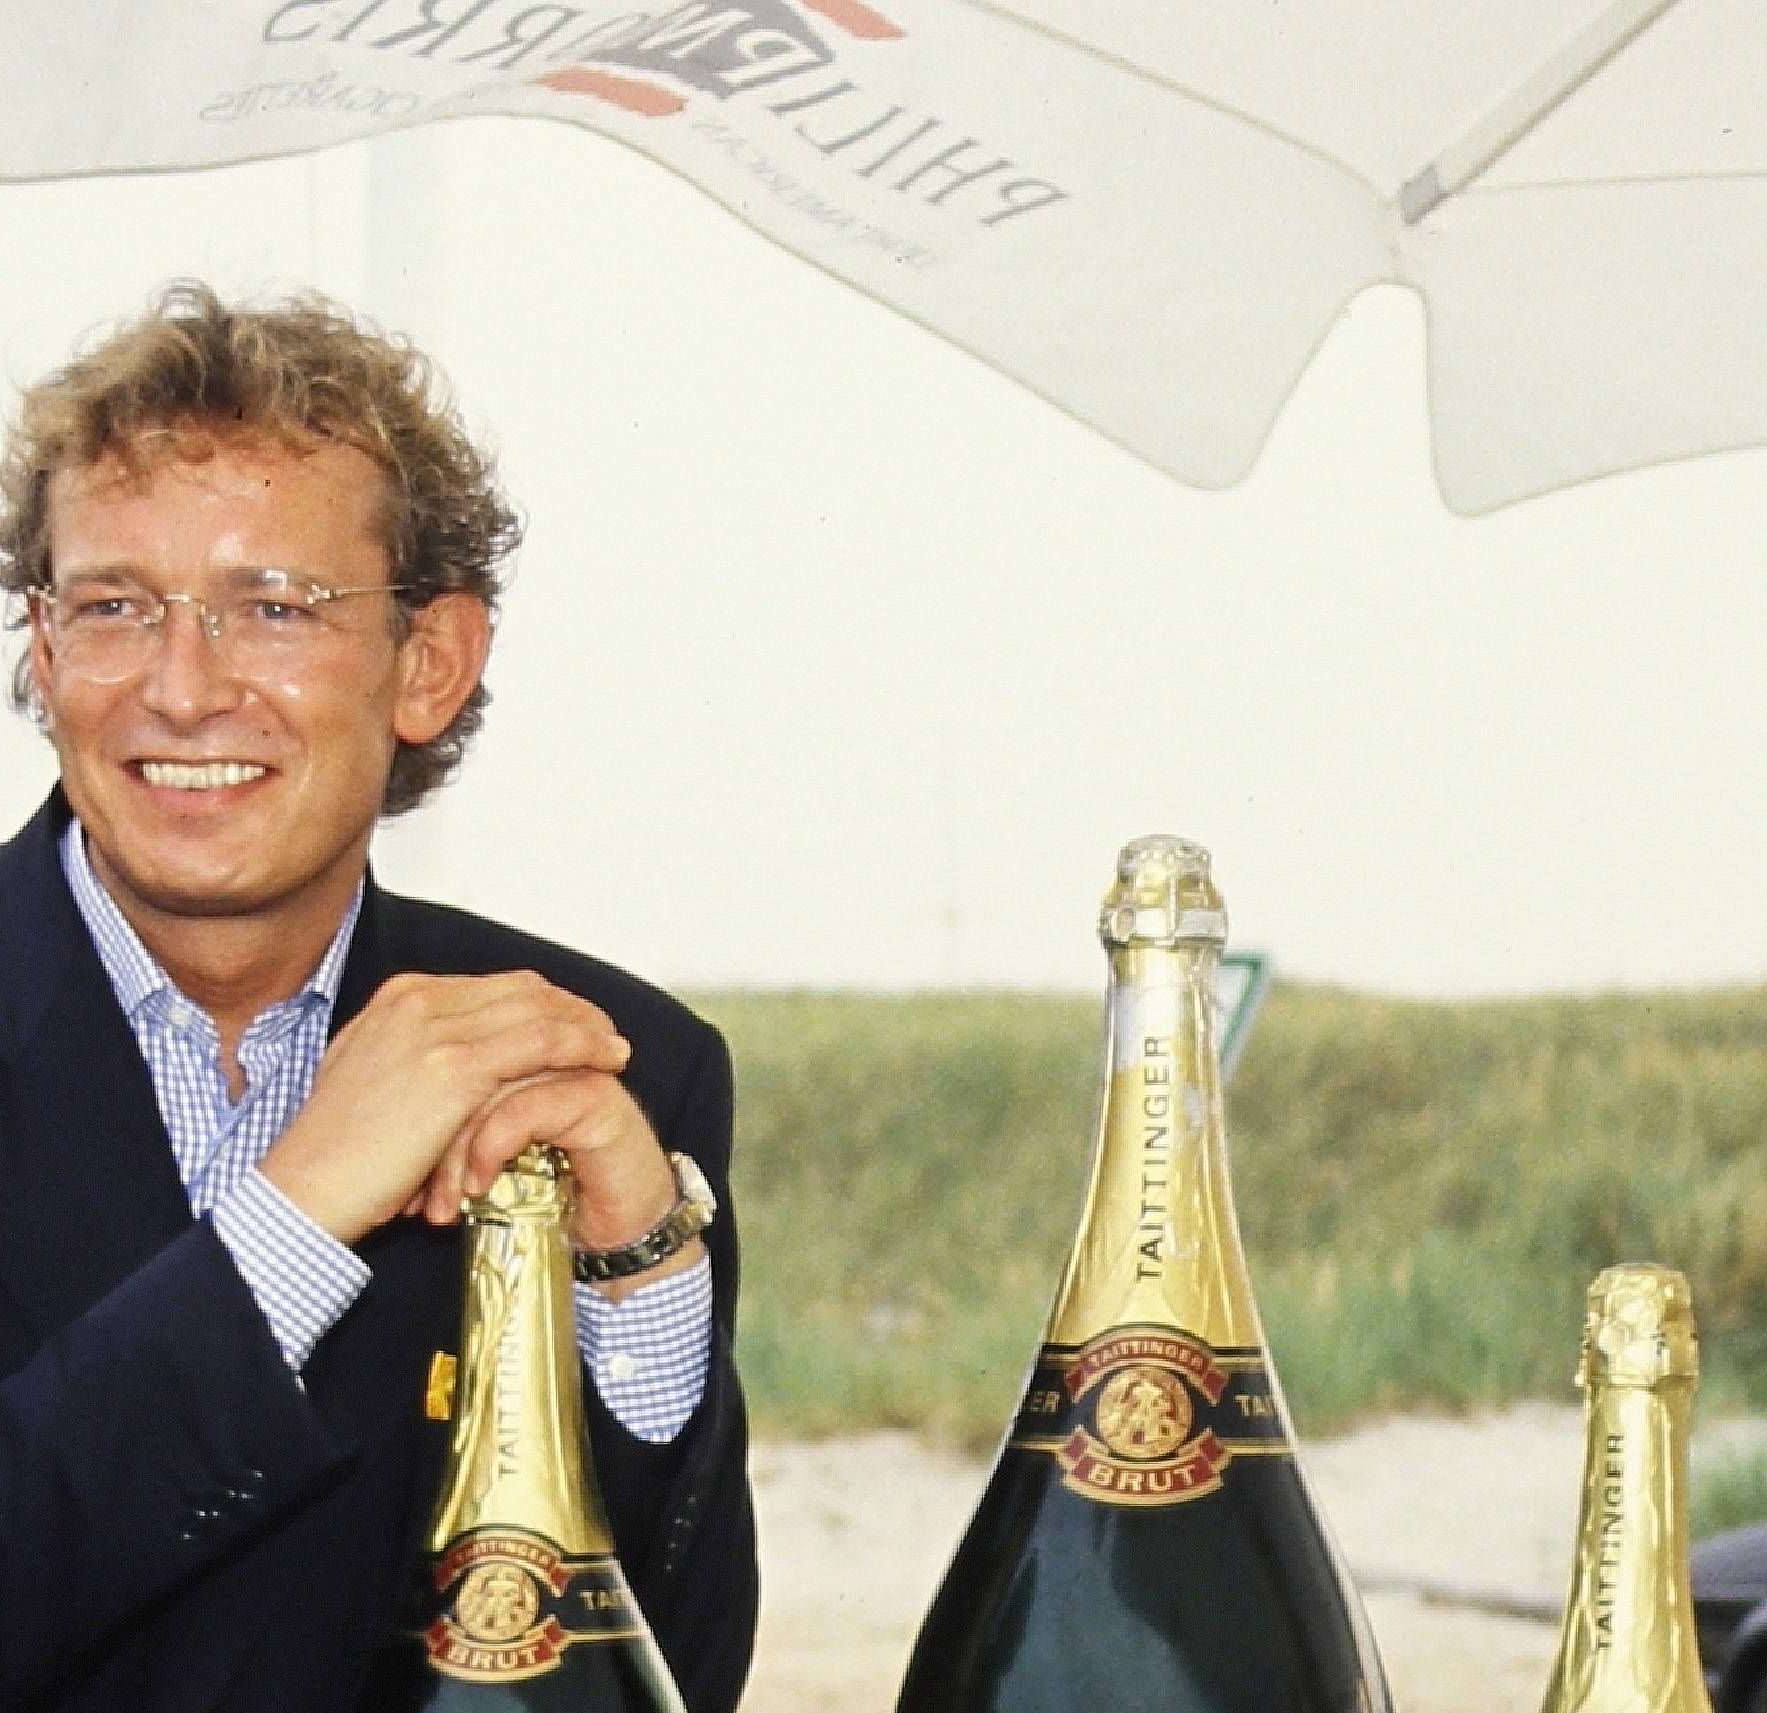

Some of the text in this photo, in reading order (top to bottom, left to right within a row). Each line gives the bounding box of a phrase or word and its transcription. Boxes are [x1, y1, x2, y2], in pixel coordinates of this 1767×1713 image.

[1135, 1035, 1171, 1283] TAITTINGER
[1088, 1463, 1197, 1492] BRUT
[1595, 1433, 1624, 1650] TAITTINGER
[448, 1645, 537, 1669] BRUT
